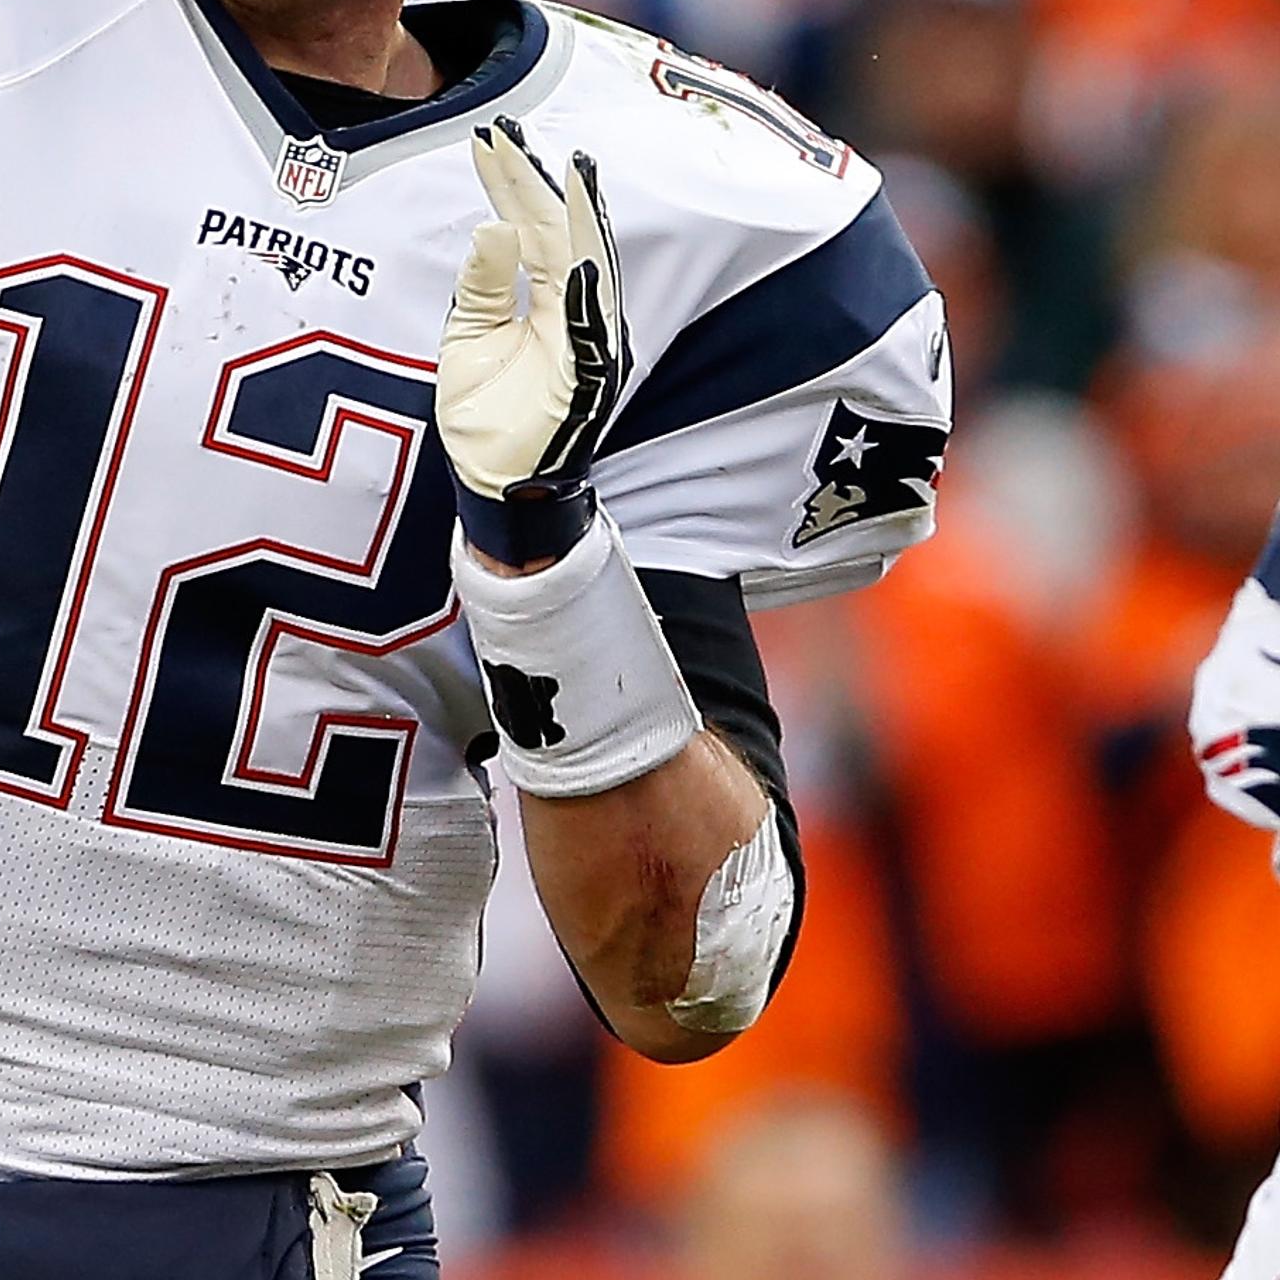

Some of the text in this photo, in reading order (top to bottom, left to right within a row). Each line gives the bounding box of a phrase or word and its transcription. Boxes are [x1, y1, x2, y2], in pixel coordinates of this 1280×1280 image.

[650, 38, 850, 179] 1
[283, 162, 327, 198] NFL
[197, 209, 375, 297] PATRIOTS
